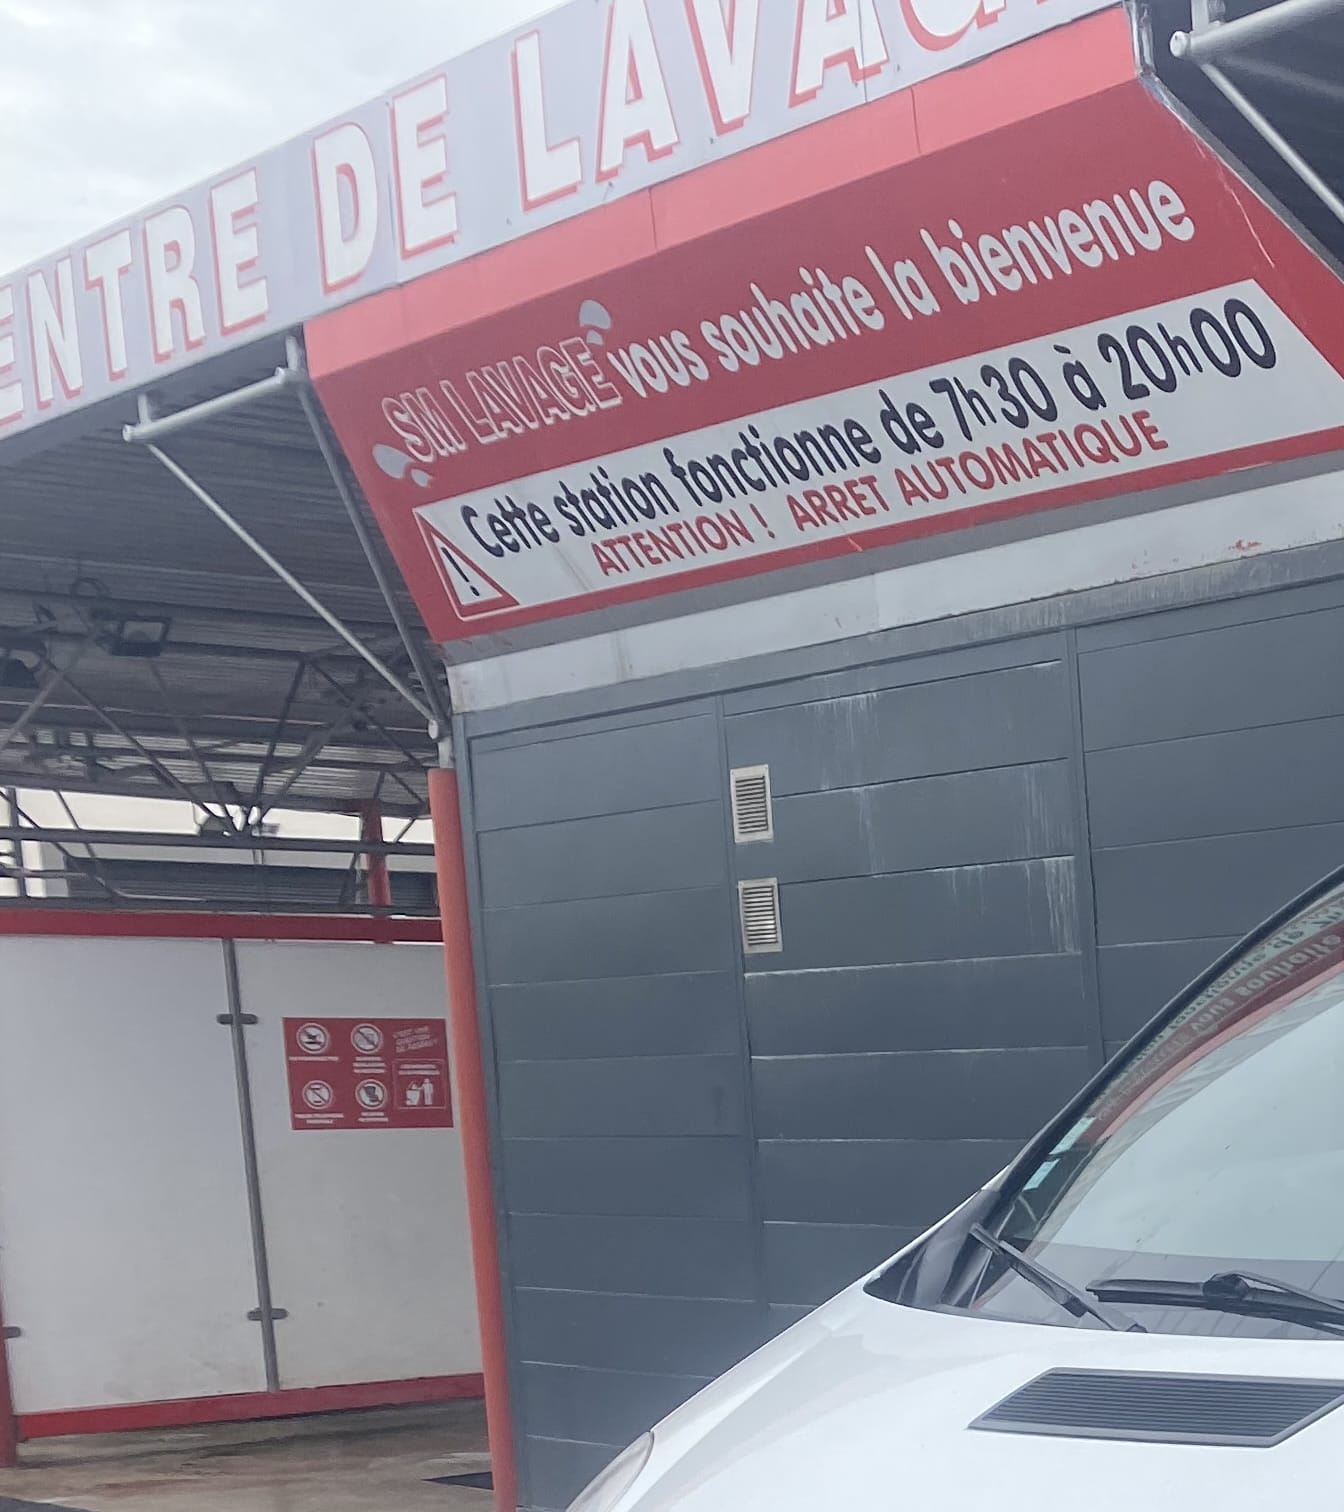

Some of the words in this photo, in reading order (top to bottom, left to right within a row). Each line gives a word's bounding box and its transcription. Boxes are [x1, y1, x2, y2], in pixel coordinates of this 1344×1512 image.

[309, 74, 458, 295] DE
[382, 382, 465, 463] SM
[464, 337, 623, 446] LAVAGE
[608, 329, 710, 398] vous
[701, 266, 885, 373] souhaite
[865, 245, 941, 320] la
[921, 179, 1195, 304] bienvenue
[460, 496, 560, 558] Cette
[553, 464, 680, 538] station
[663, 416, 882, 508] fonctionne
[880, 389, 945, 455] de
[929, 356, 1058, 442] 7h30
[1053, 344, 1107, 410] à
[1097, 297, 1277, 400] 20h00
[591, 512, 757, 577] ATTENTION
[786, 474, 890, 532] ARRET
[894, 409, 1168, 507] AUTOMATIQUE
